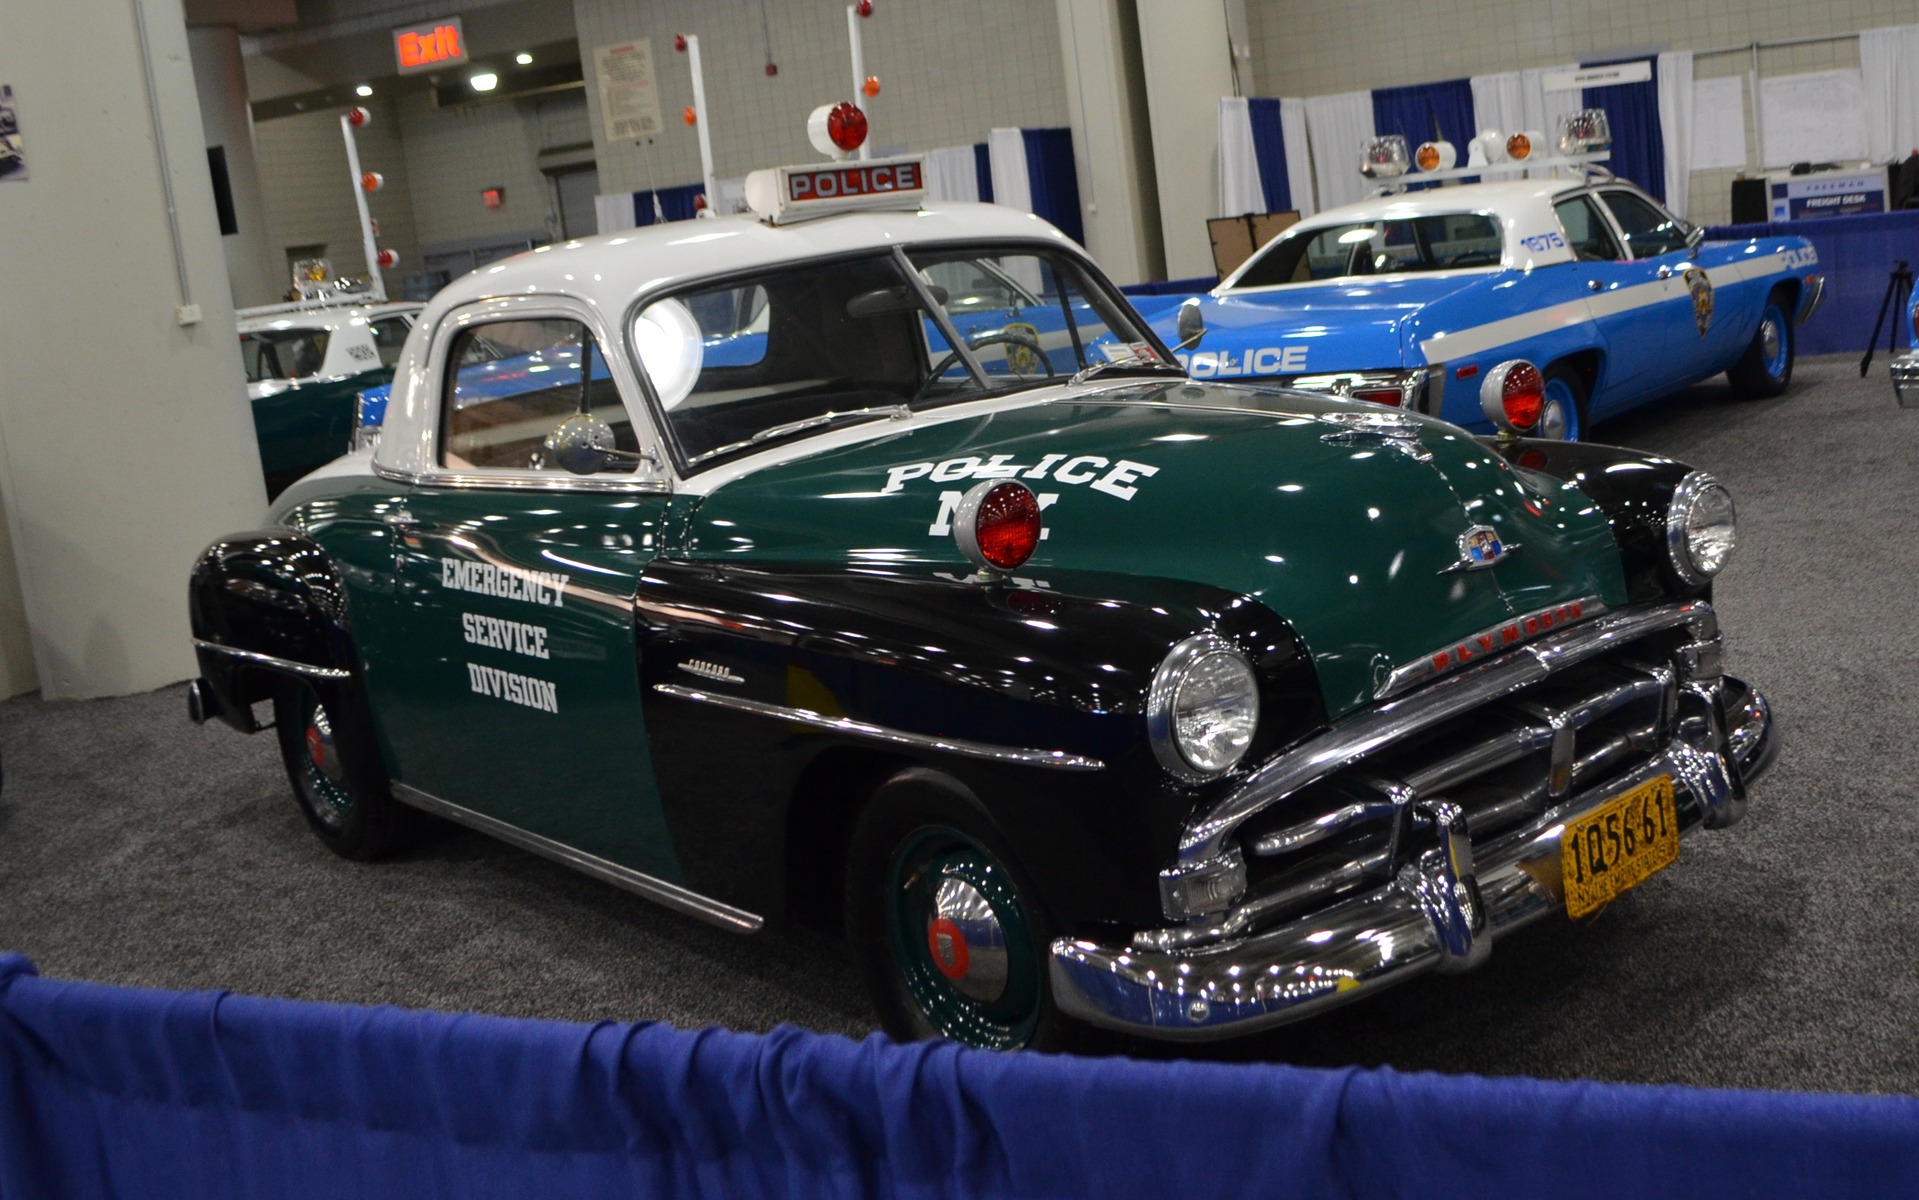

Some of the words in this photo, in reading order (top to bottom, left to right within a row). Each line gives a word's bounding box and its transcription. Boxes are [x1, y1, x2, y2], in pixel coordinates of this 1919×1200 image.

[398, 25, 461, 67] Exit
[791, 165, 915, 199] POLICE
[1806, 195, 1841, 208] FREIGHT
[1842, 194, 1866, 205] DESK
[881, 454, 1160, 501] POLICE
[442, 557, 569, 607] EMERGENCY
[462, 612, 550, 659] SERVICE
[1432, 603, 1582, 671] PLYMOUTH
[467, 662, 558, 714] DIVISION
